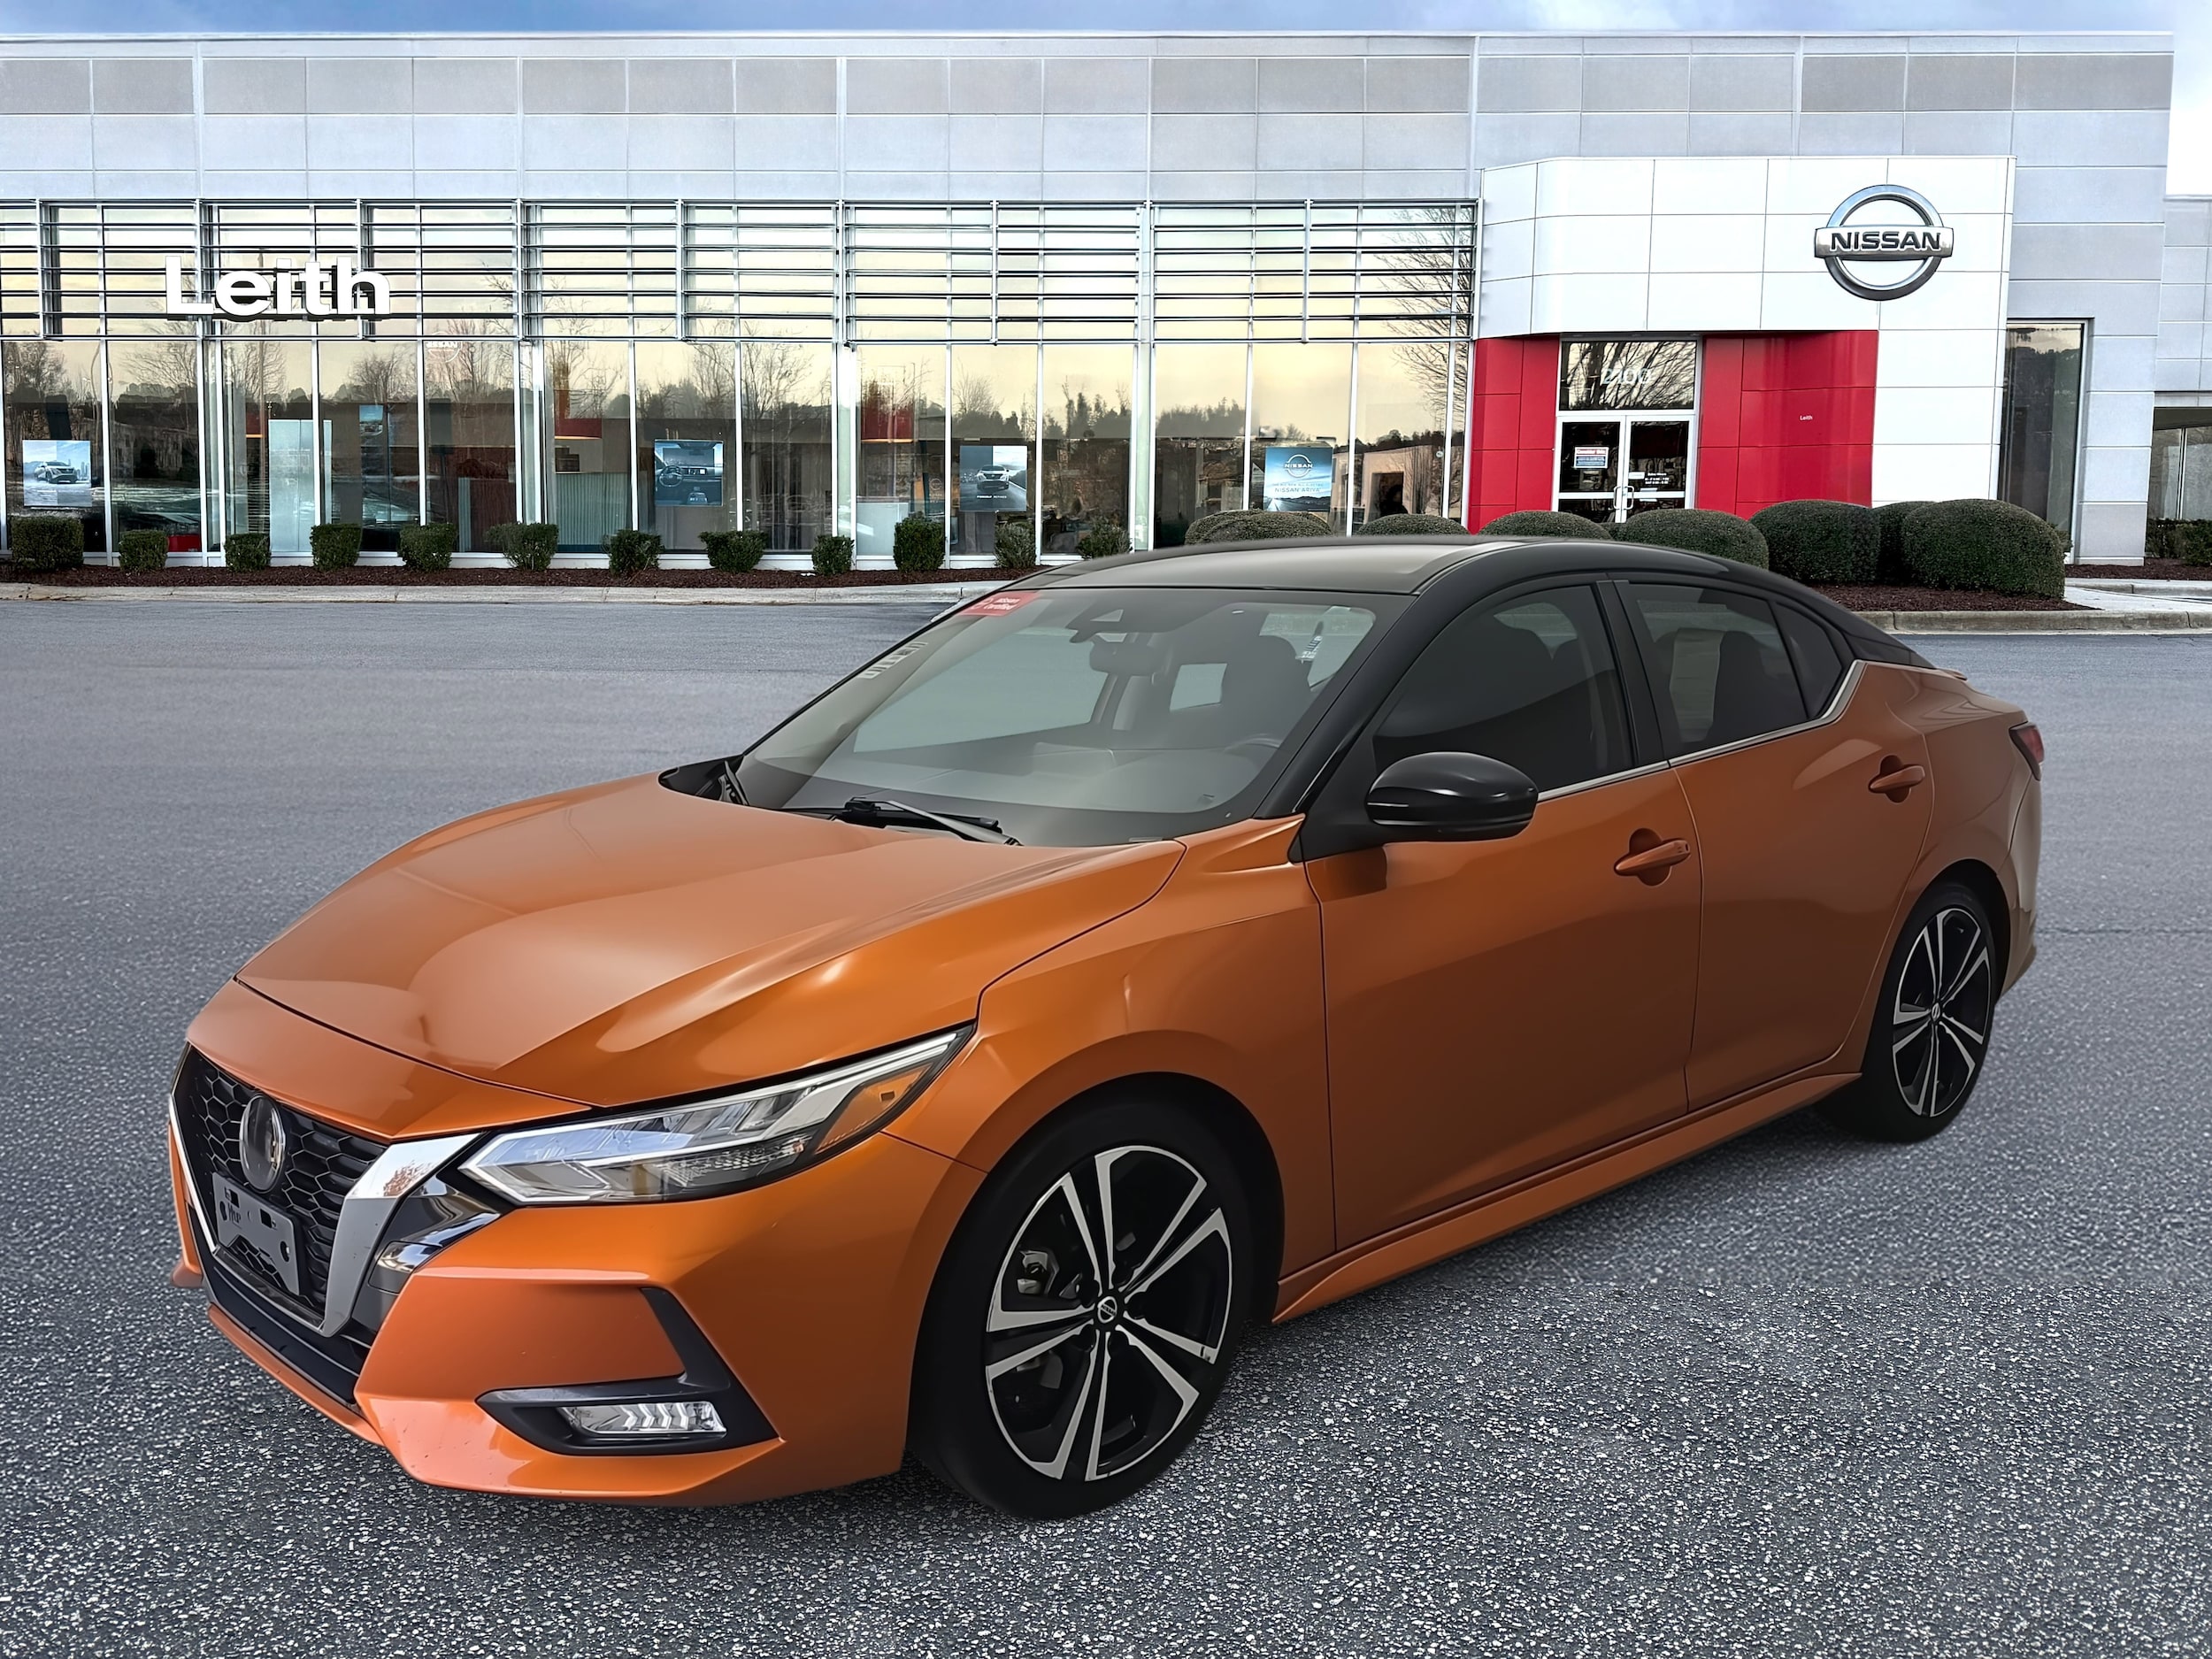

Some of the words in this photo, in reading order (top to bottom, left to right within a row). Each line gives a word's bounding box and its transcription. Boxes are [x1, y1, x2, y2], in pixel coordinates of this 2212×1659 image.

[1831, 231, 1940, 250] NISSAN
[165, 256, 390, 316] Leith
[1602, 368, 1651, 384] 2100
